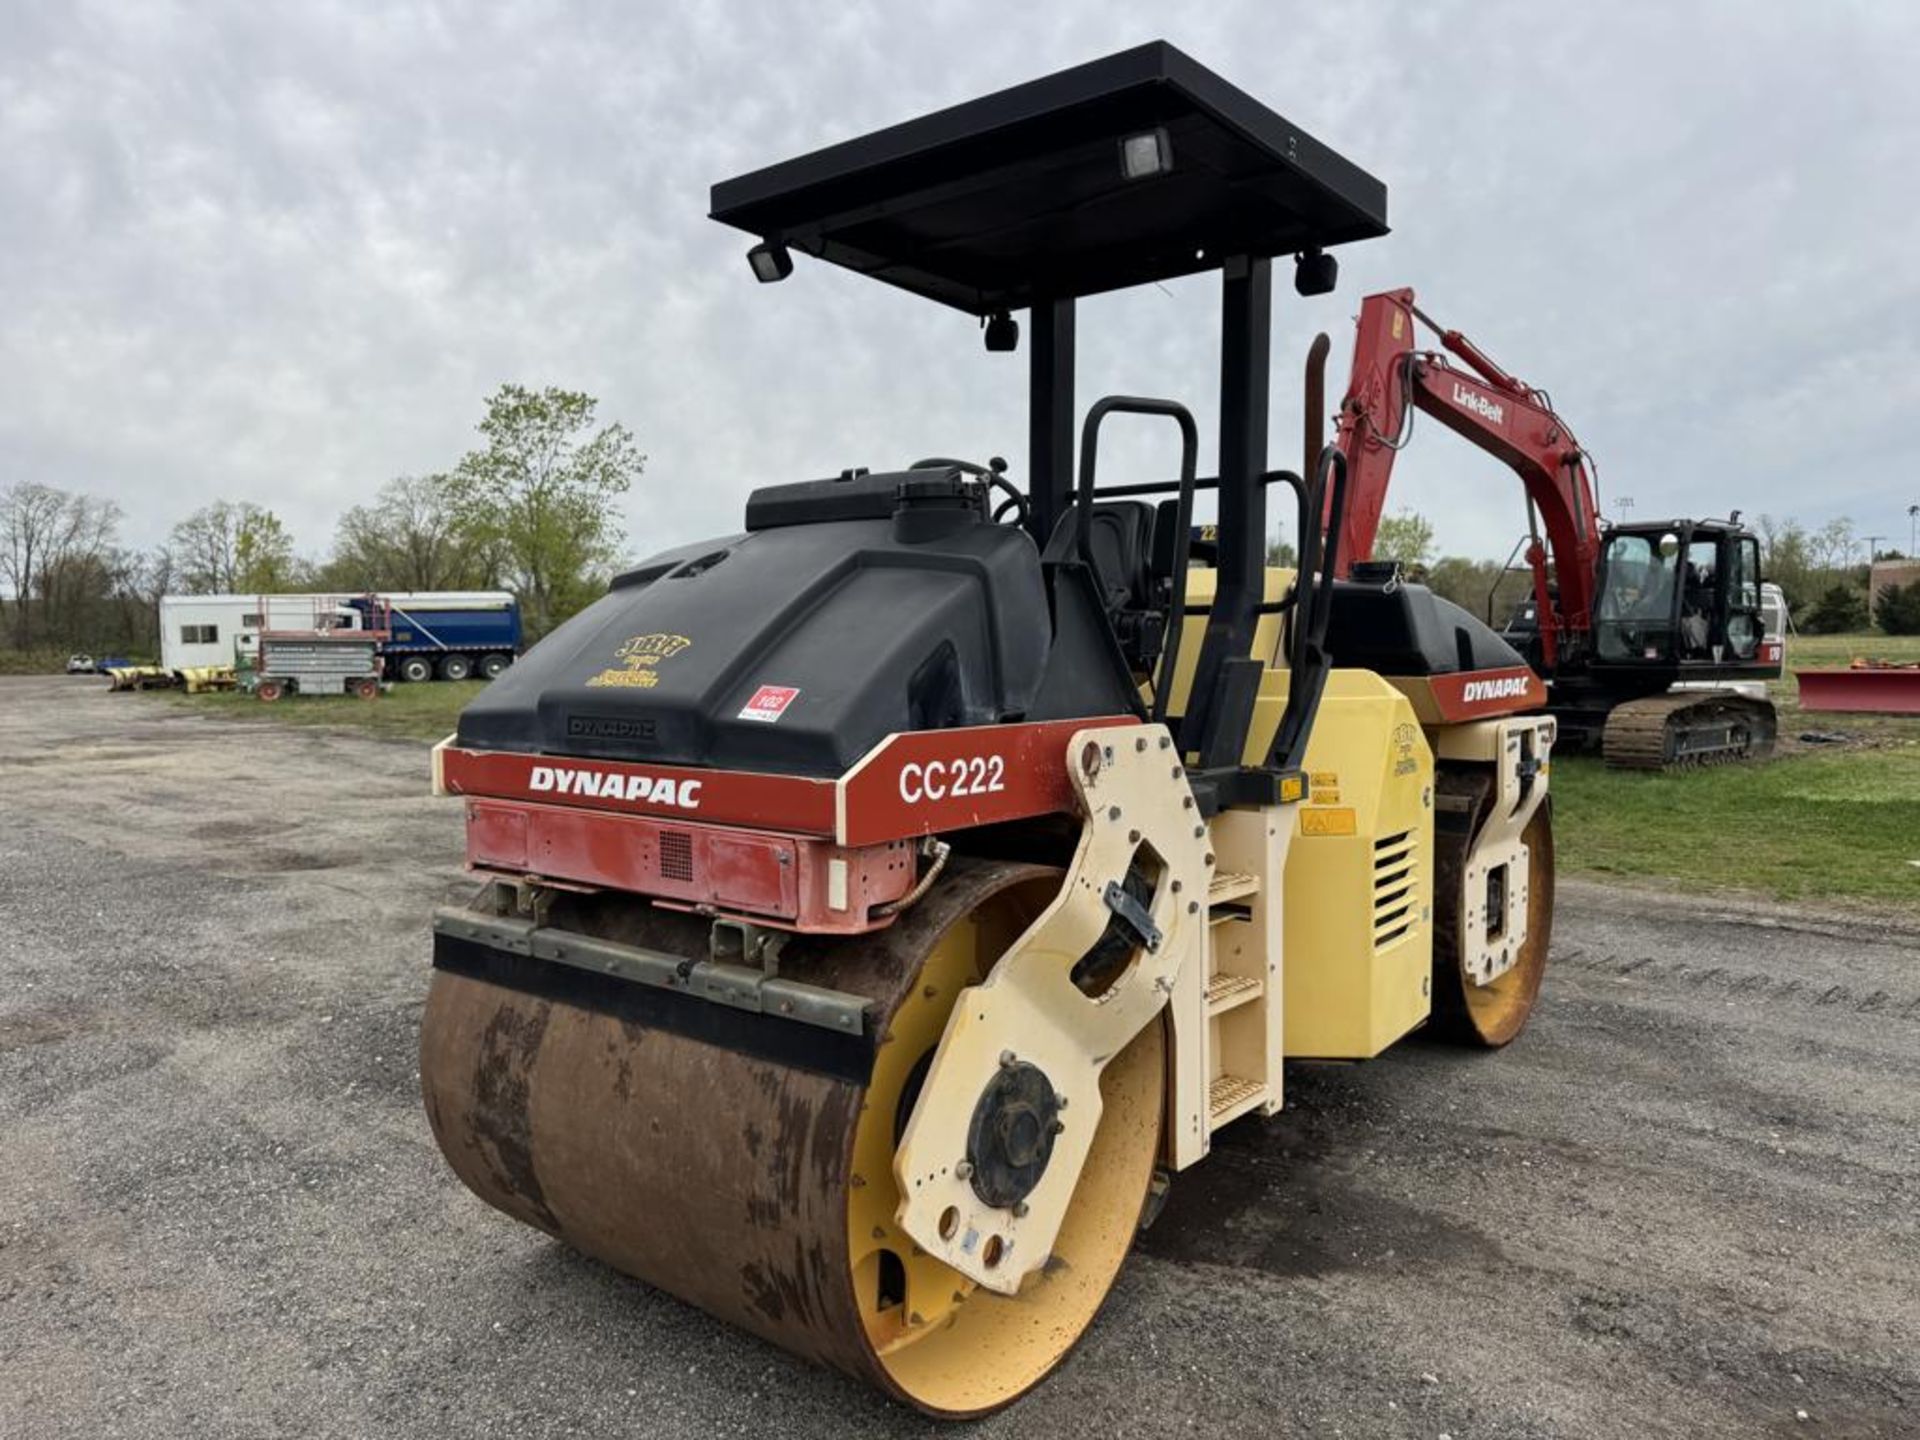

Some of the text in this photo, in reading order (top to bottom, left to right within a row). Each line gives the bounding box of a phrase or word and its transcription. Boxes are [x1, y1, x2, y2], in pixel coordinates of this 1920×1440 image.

[1453, 383, 1502, 424] Link-Belt
[1463, 676, 1529, 703] DYNAPAC
[529, 766, 702, 808] DYNAPAC
[899, 754, 1004, 804] CC 222
